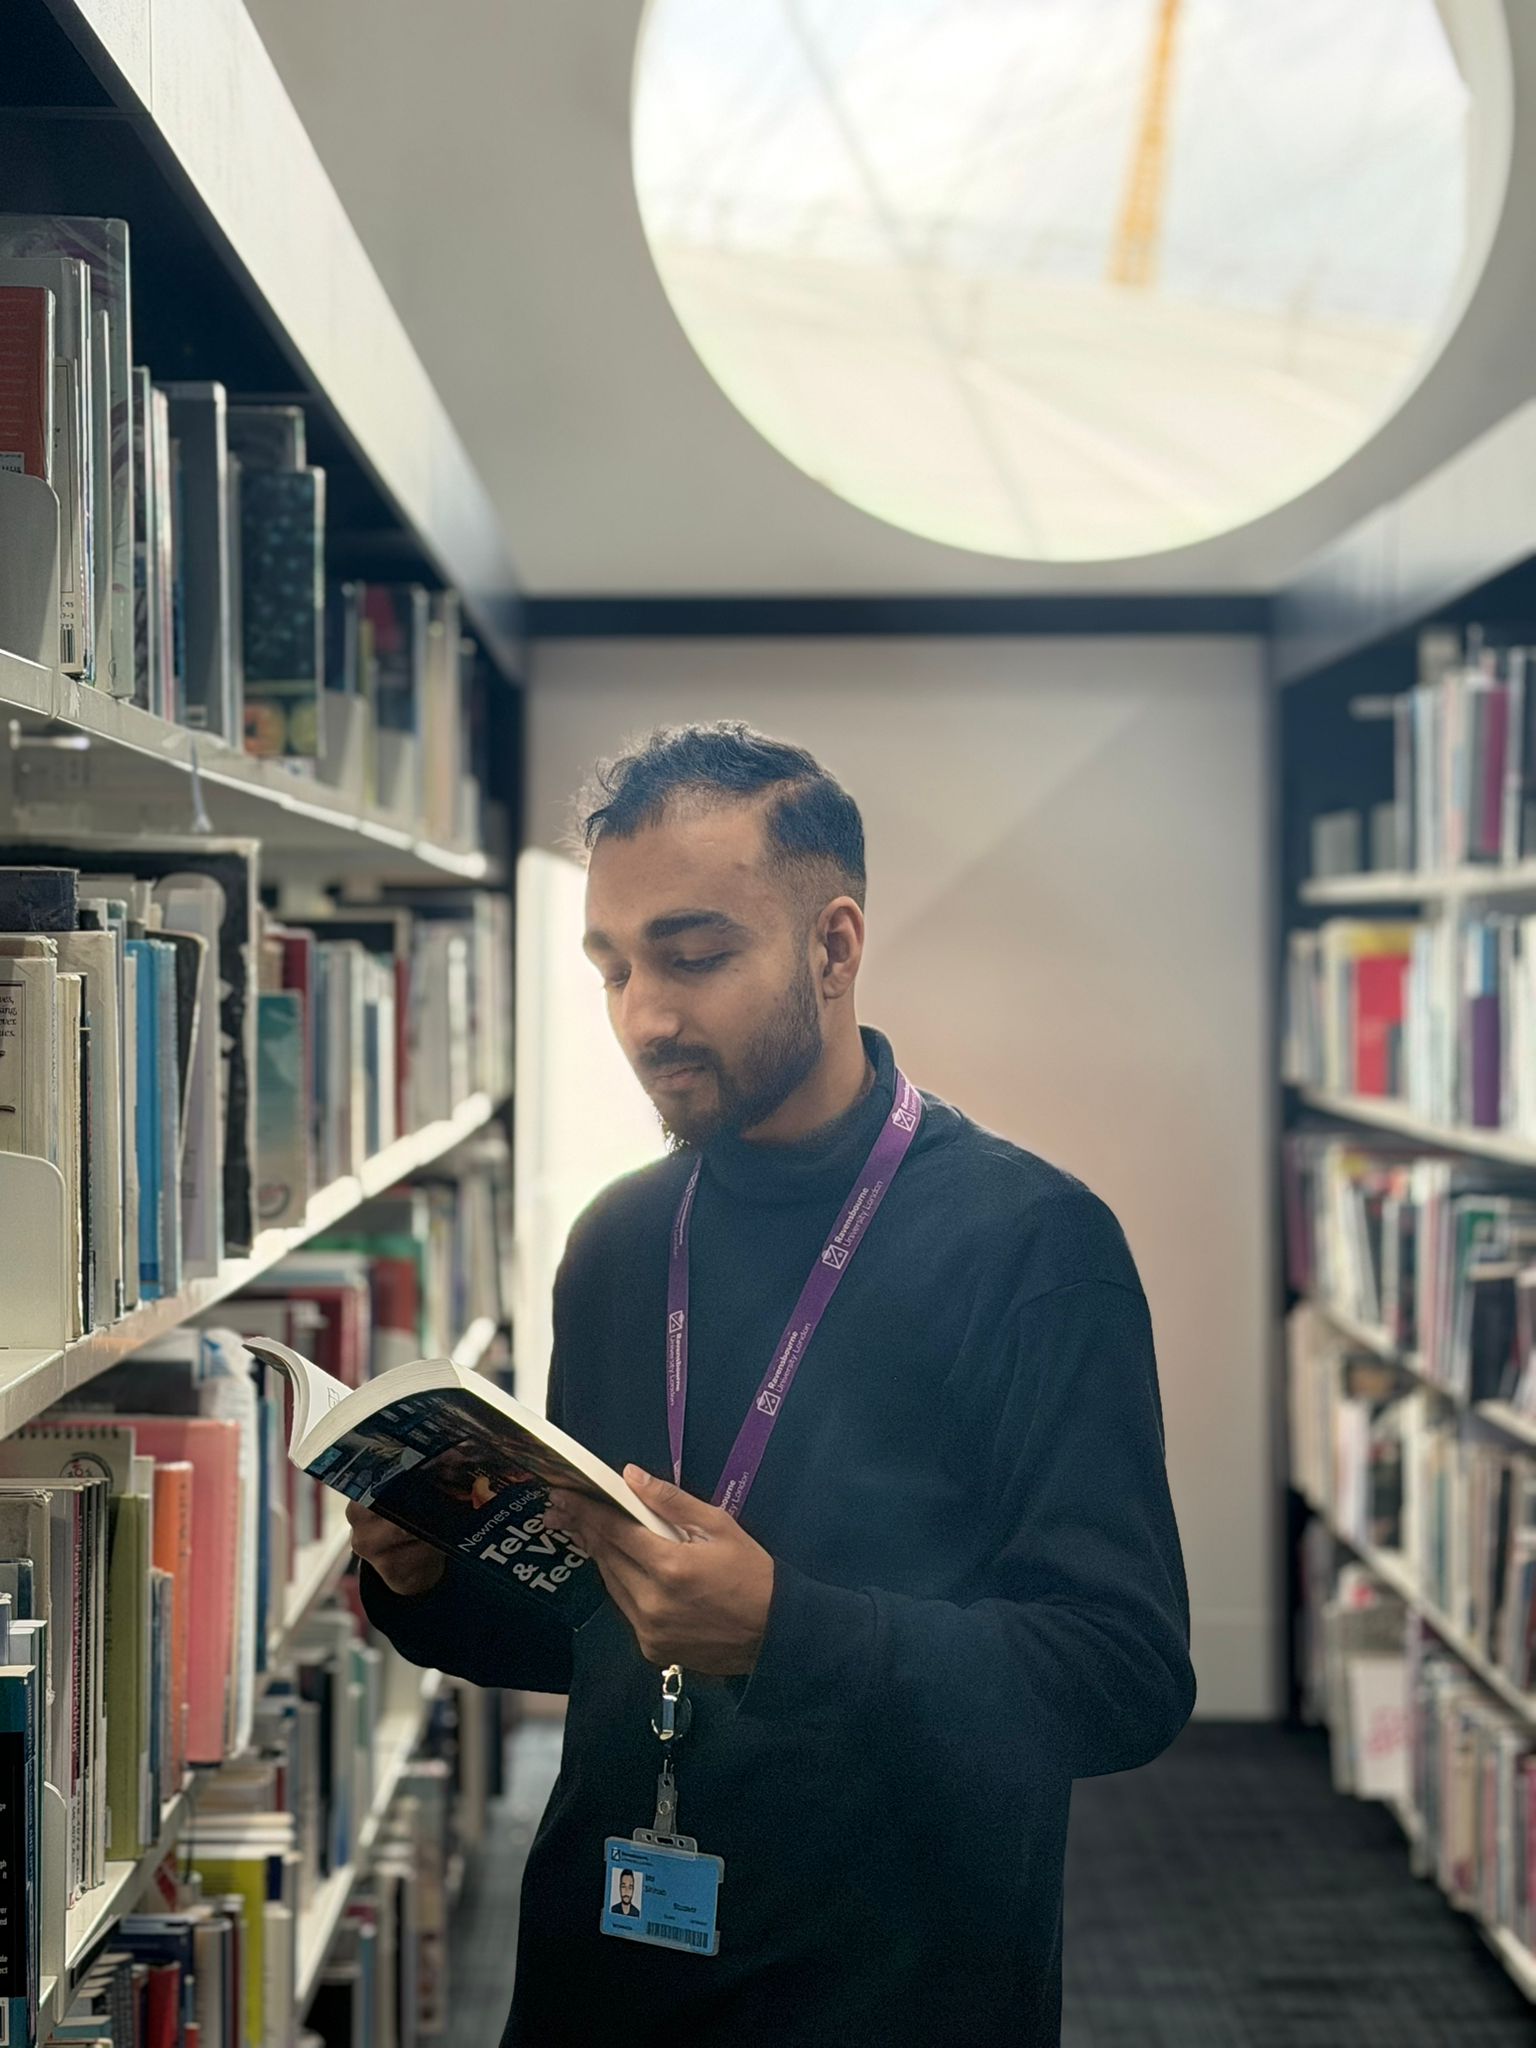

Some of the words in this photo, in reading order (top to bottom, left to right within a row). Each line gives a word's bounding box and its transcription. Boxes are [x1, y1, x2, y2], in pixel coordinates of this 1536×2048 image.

[834, 1187, 870, 1244] Ravensbourne
[843, 1210, 869, 1247] University
[863, 1180, 884, 1210] London
[792, 1322, 812, 1354] London
[767, 1331, 799, 1390] Ravensbourne
[731, 1471, 750, 1503] London
[457, 1508, 511, 1553] Newnes
[525, 1529, 572, 1556] Vi
[512, 1562, 540, 1582] &
